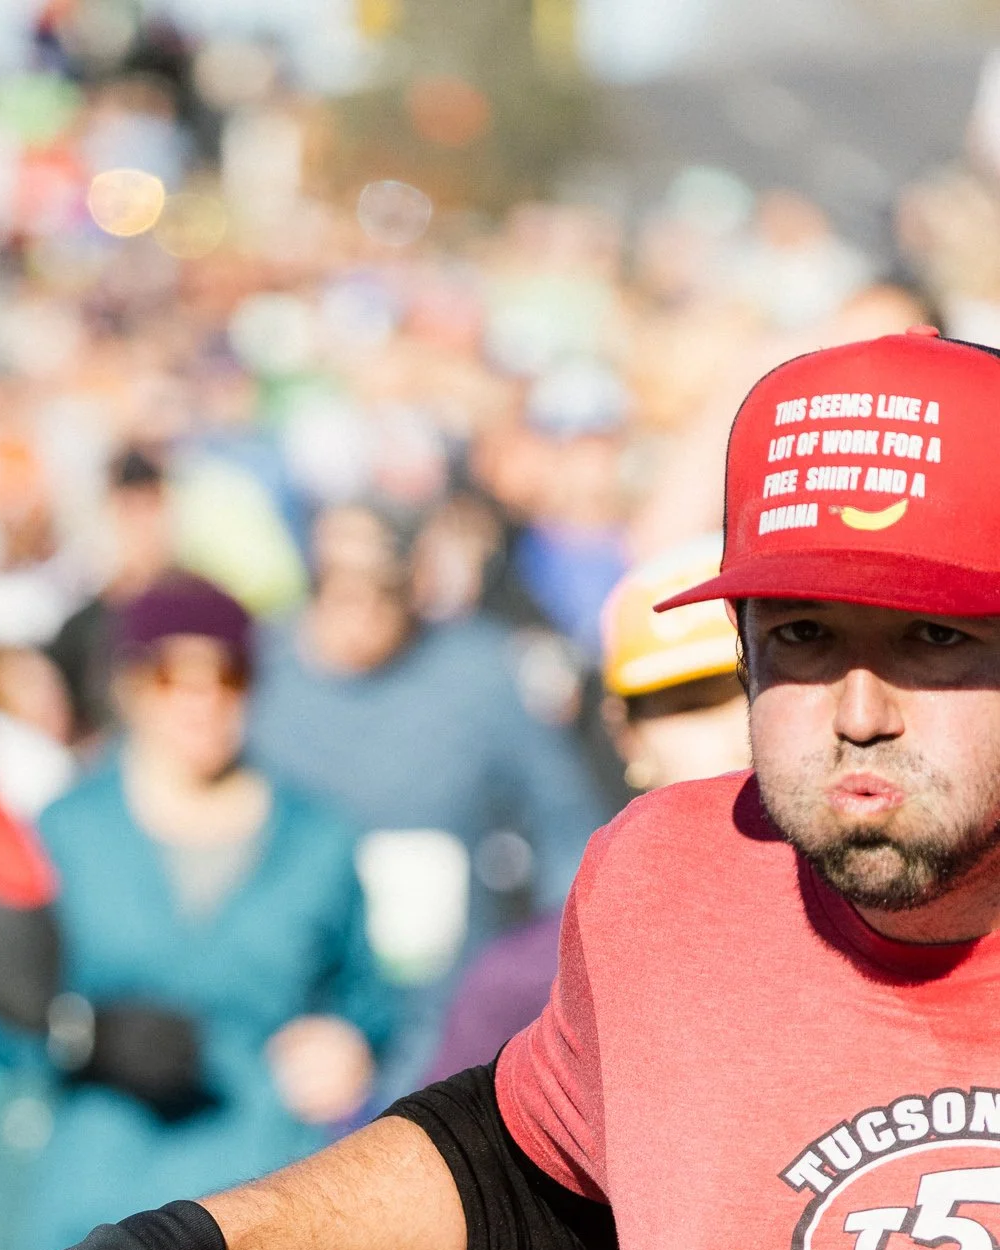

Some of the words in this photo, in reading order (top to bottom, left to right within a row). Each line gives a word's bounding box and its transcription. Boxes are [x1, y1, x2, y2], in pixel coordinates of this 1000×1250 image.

[774, 398, 807, 426] THIS
[809, 394, 873, 420] SEEMS
[876, 394, 922, 422] LIKE
[924, 401, 940, 425] A
[768, 434, 796, 463] LOT
[797, 431, 819, 456] OF
[822, 430, 879, 455] WORK
[882, 431, 923, 459] FOR
[926, 437, 941, 463] A
[763, 469, 799, 499] FREE
[805, 466, 862, 491] SHIRT
[863, 467, 907, 494] AND
[909, 473, 926, 498] A
[758, 503, 818, 536] BANANA
[781, 1088, 1000, 1193] TUCSON
